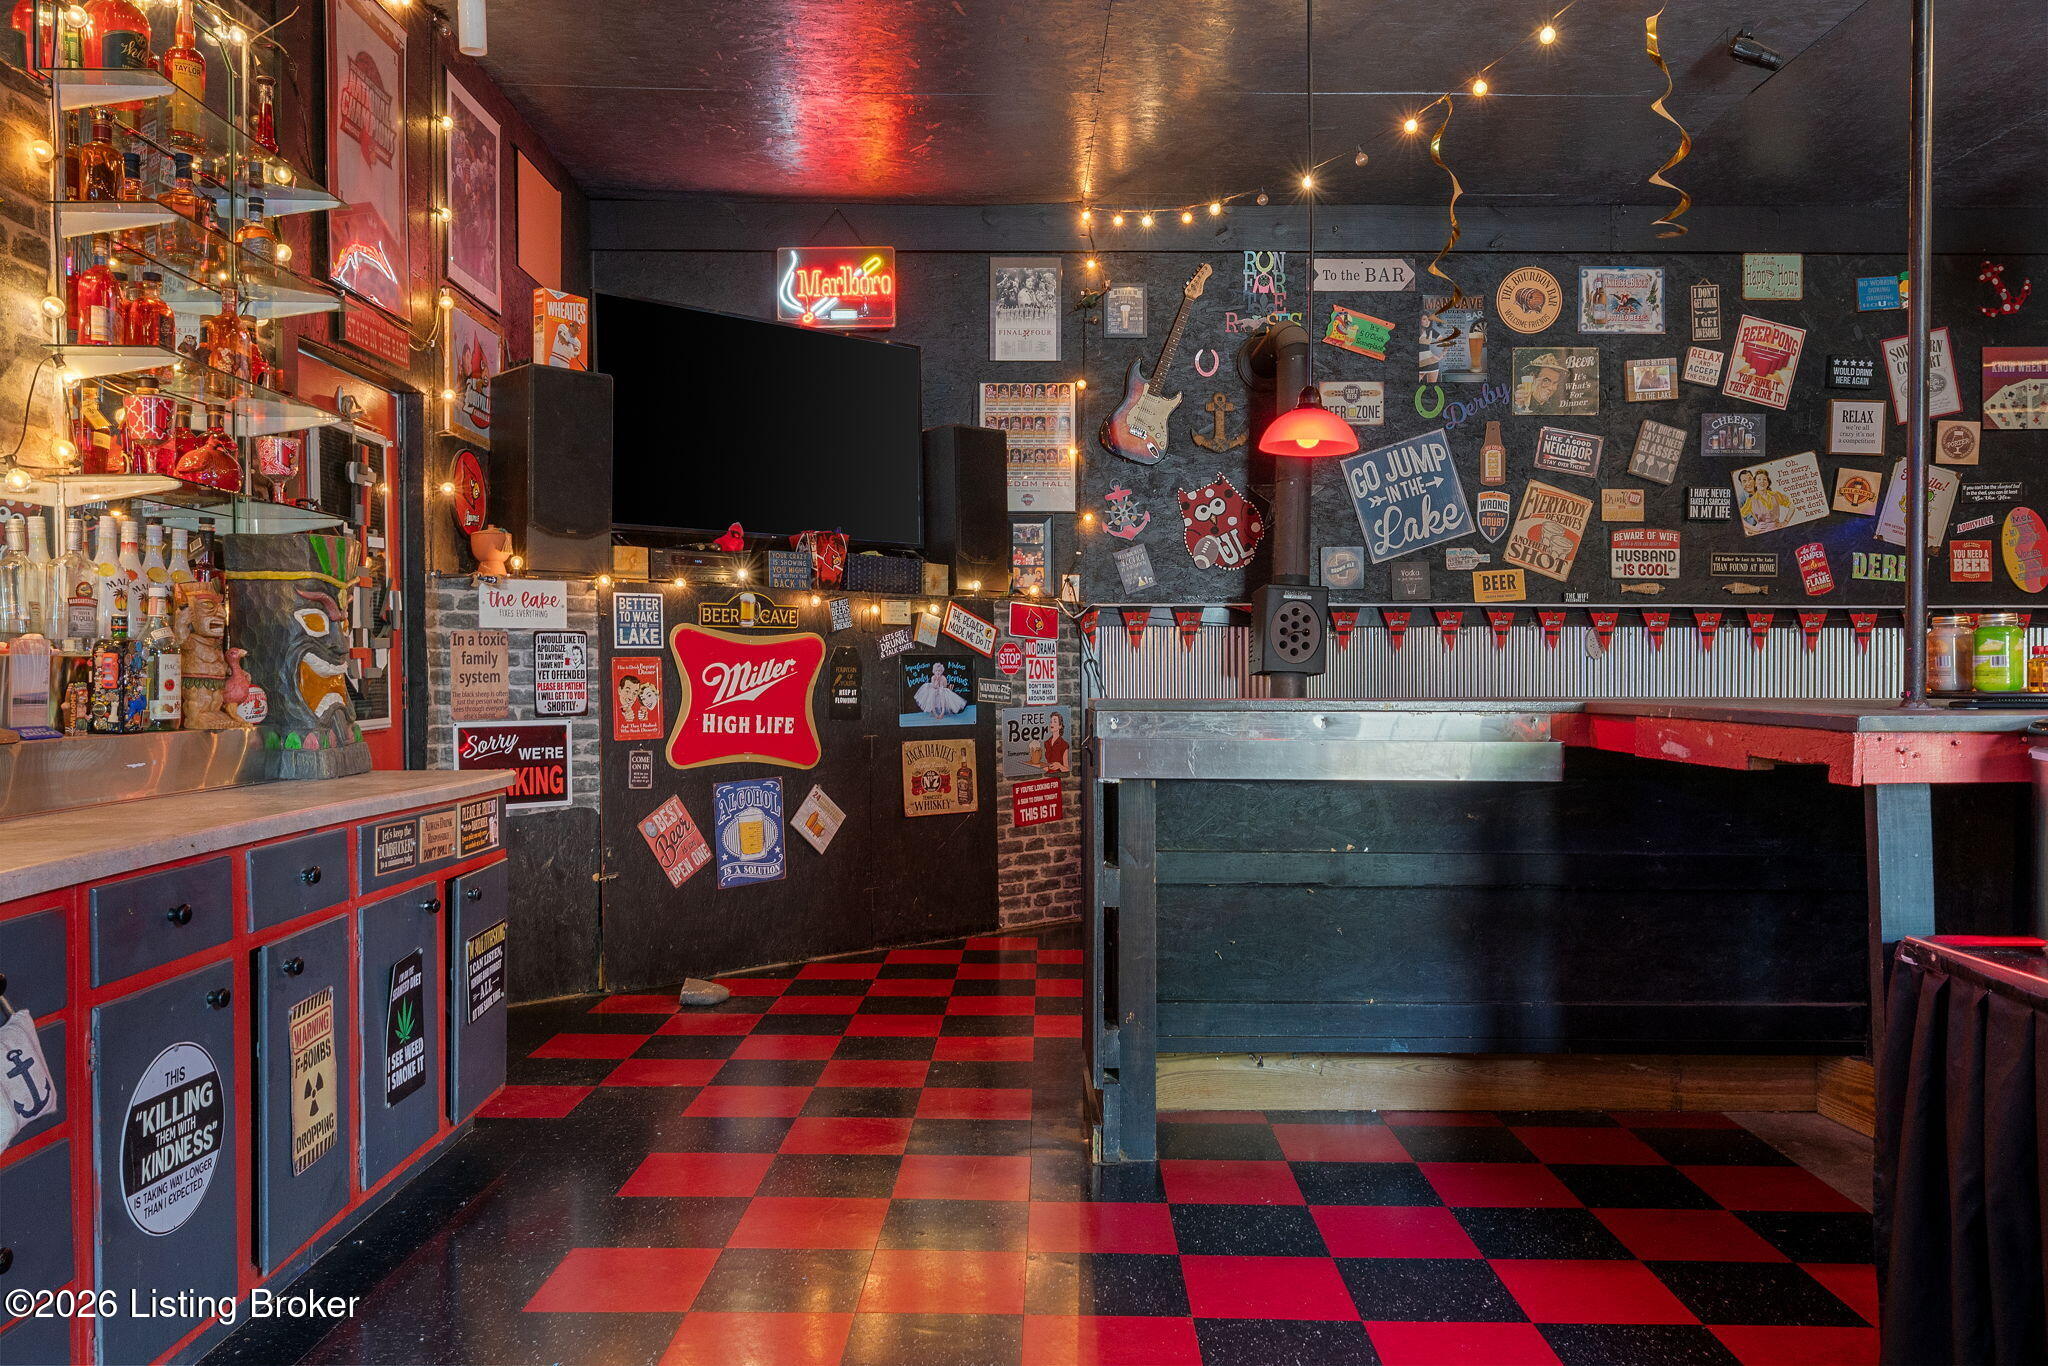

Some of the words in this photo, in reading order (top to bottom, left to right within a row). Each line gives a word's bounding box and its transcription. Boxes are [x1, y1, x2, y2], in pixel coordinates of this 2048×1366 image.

[175, 65, 200, 76] TAYLOR
[797, 266, 891, 297] Marlboro
[1323, 270, 1336, 280] To
[1341, 269, 1360, 280] the
[1365, 268, 1405, 282] BAR
[1502, 282, 1515, 301] THE
[1513, 272, 1551, 289] BOURBON
[1546, 286, 1556, 307] BAR
[547, 302, 586, 325] WHEATIES
[1505, 310, 1528, 328] WELCOME
[1528, 314, 1550, 328] FRIENDS
[1742, 327, 1772, 343] BEER
[1774, 330, 1798, 356] PONG
[1565, 356, 1594, 368] BEER
[1691, 350, 1721, 363] RELAX
[1689, 365, 1719, 376] ACCEPT
[1834, 367, 1854, 375] WOULD
[1856, 368, 1872, 376] DRINK
[1992, 362, 2015, 372] KNOW
[2019, 362, 2042, 372] WHEN
[1574, 373, 1586, 381] It's
[1738, 373, 1751, 382] YOU
[1752, 376, 1770, 388] SINK
[1772, 382, 1779, 391] IT
[1836, 376, 1849, 384] HERE
[1852, 377, 1870, 385] AGAIN
[1636, 392, 1642, 400] AT
[1729, 382, 1748, 393] THEY
[1750, 387, 1771, 400] DRINK
[1773, 394, 1784, 404] IT!
[1443, 383, 1511, 430] Derby
[1712, 416, 1754, 430] CHEERS
[1842, 410, 1874, 423] RELAX
[1543, 442, 1592, 460] NEIGHBOR
[1640, 440, 1679, 461] GLASSES
[1351, 461, 1381, 498] GO
[1386, 444, 1446, 482] JUMP
[1385, 488, 1399, 504] IN
[1402, 476, 1426, 499] THE
[1480, 499, 1507, 511] WRONG
[1520, 487, 1588, 520] EVERYBODY
[1374, 495, 1465, 555] Lake
[1482, 517, 1504, 528] DOUBT
[1545, 513, 1583, 530] DESERVES
[1957, 515, 1994, 533] LOUISVILLE
[1513, 536, 1550, 552] ANOTHER
[1614, 532, 1644, 541] BEWARE
[1647, 532, 1656, 540] OF
[1659, 533, 1678, 542] WIFE
[1508, 543, 1568, 574] SHOT
[1616, 550, 1675, 562] HUSBAND
[1954, 550, 1965, 558] YOU
[1967, 550, 1982, 558] NEED
[1984, 550, 1988, 558] A
[1623, 564, 1634, 576] IS
[1638, 564, 1669, 576] COOL
[1713, 563, 1728, 571] THAN
[1730, 563, 1748, 572] FOUND
[1760, 564, 1775, 572] HOME
[1954, 559, 1989, 572] BEER
[1482, 574, 1516, 592] BEER
[1806, 575, 1831, 588] FLAME
[489, 591, 517, 606] the
[521, 592, 560, 608] lake
[619, 597, 658, 610] BETTER
[499, 609, 514, 617] FIXES
[516, 609, 548, 618] EVERYTHING
[620, 612, 631, 622] TO
[632, 611, 658, 623] WAKE
[702, 611, 739, 623] BEER
[759, 611, 797, 624] CAVE
[953, 609, 962, 619] THE
[963, 616, 984, 632] BEAVER
[453, 633, 466, 646] In
[468, 636, 474, 646] a
[479, 633, 506, 646] toxic
[620, 629, 659, 645] LAKE
[1026, 642, 1035, 655] NO
[1036, 642, 1055, 655] DRAMA
[462, 651, 498, 668] family
[1000, 653, 1020, 664] STOP
[538, 671, 550, 679] YET
[552, 670, 585, 679] OFFENDED
[1029, 660, 1054, 679] ZONE
[459, 672, 500, 688] system
[557, 682, 563, 690] BE
[564, 682, 585, 690] PATIENT
[702, 658, 796, 705] Miller
[702, 714, 751, 733] HIGH
[756, 717, 795, 734] LIFE
[1022, 714, 1045, 724] FREE
[1008, 720, 1049, 742] Beer
[463, 734, 519, 759] Sorry
[518, 747, 563, 760] WE'RE
[906, 747, 923, 764] JACK
[925, 744, 956, 762] DANIEL'S
[718, 789, 780, 824] ALCOHOL
[915, 802, 950, 811] WHISKEY
[1020, 809, 1038, 822] THIS
[1039, 808, 1048, 820] IS
[1049, 805, 1057, 817] IT
[653, 801, 684, 833] BEST
[656, 818, 694, 868] Beer
[668, 860, 694, 885] OPEN
[693, 843, 712, 866] ONE
[724, 867, 731, 875] IS
[734, 867, 741, 875] A
[744, 864, 780, 875] SOLUTION
[480, 978, 492, 999] ALL
[294, 1013, 329, 1047] WARNING
[295, 1039, 331, 1079] F-BOMBS
[388, 1057, 390, 1071] I
[392, 1050, 403, 1069] SEE
[405, 1038, 423, 1060] WEED
[165, 1066, 185, 1087] THIS
[388, 1078, 390, 1093] I
[392, 1063, 415, 1089] SMOKE
[417, 1057, 424, 1073] IT
[156, 1128, 176, 1148] THEM
[178, 1116, 196, 1137] WITH
[297, 1113, 334, 1154] DROPPING
[134, 1197, 141, 1210] IS
[143, 1180, 168, 1204] TAKING
[169, 1174, 184, 1191] WAY
[185, 1158, 212, 1182] LONGER
[144, 1200, 162, 1220] THAN
[164, 1199, 167, 1208] I
[168, 1178, 204, 1205] EXPECTED.
